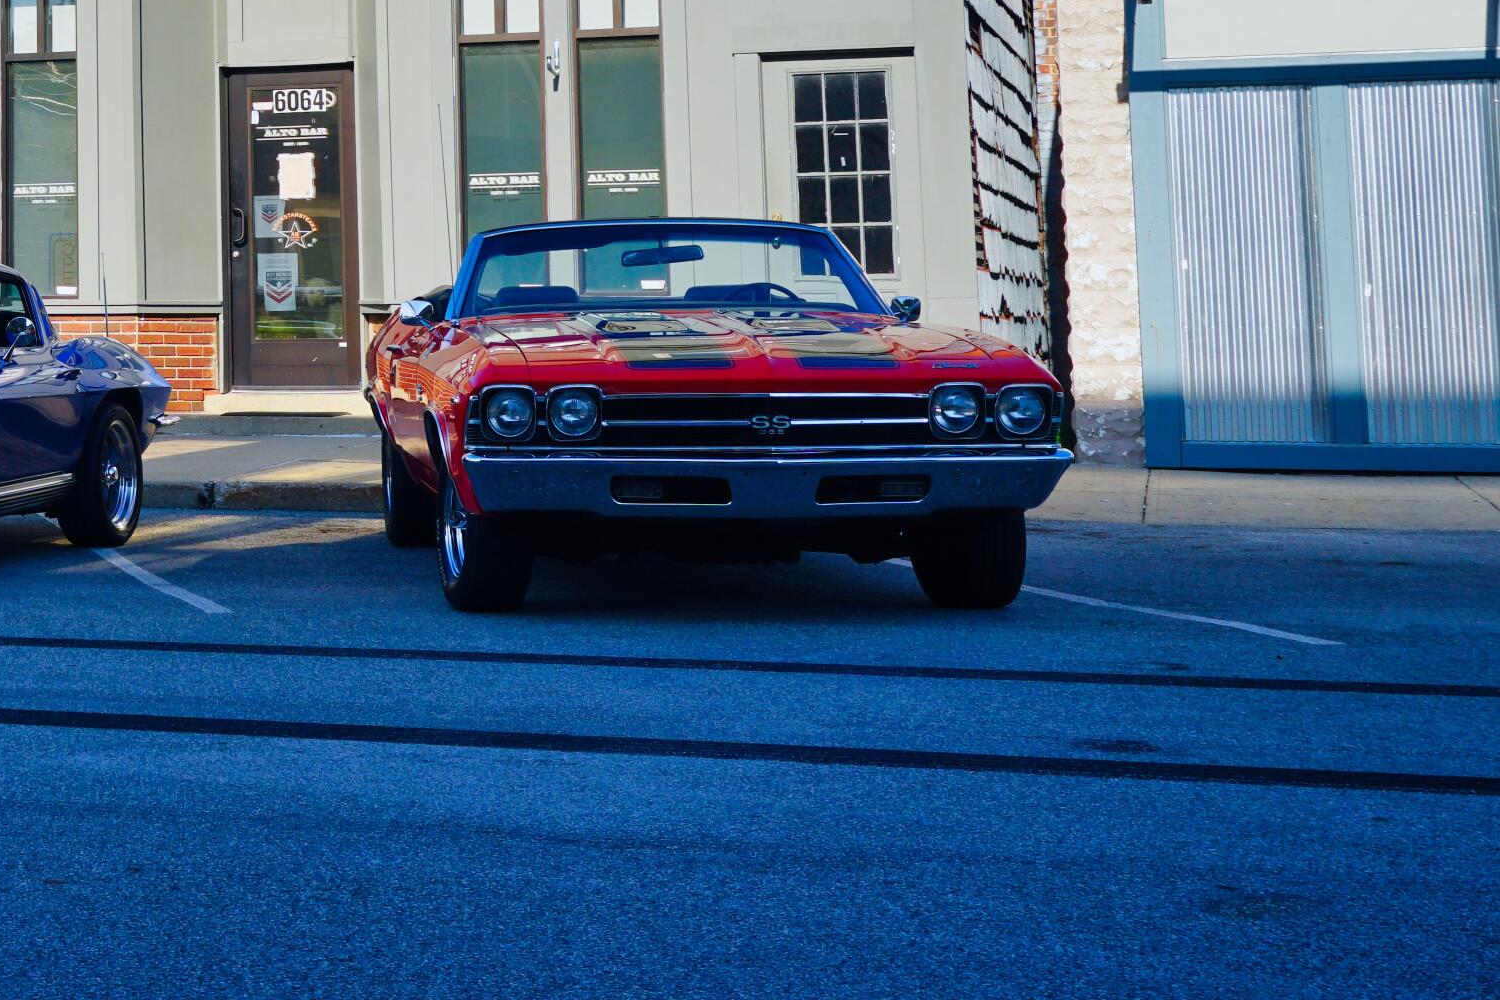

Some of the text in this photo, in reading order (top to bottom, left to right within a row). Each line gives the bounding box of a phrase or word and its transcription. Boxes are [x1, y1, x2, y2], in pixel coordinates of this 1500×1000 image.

[274, 89, 325, 112] 6064
[263, 127, 328, 137] ALTO BAR
[469, 175, 540, 185] ALTO BAR
[587, 172, 660, 182] ALTO BAR
[13, 185, 76, 194] ALTO BAR
[752, 415, 790, 429] SS
